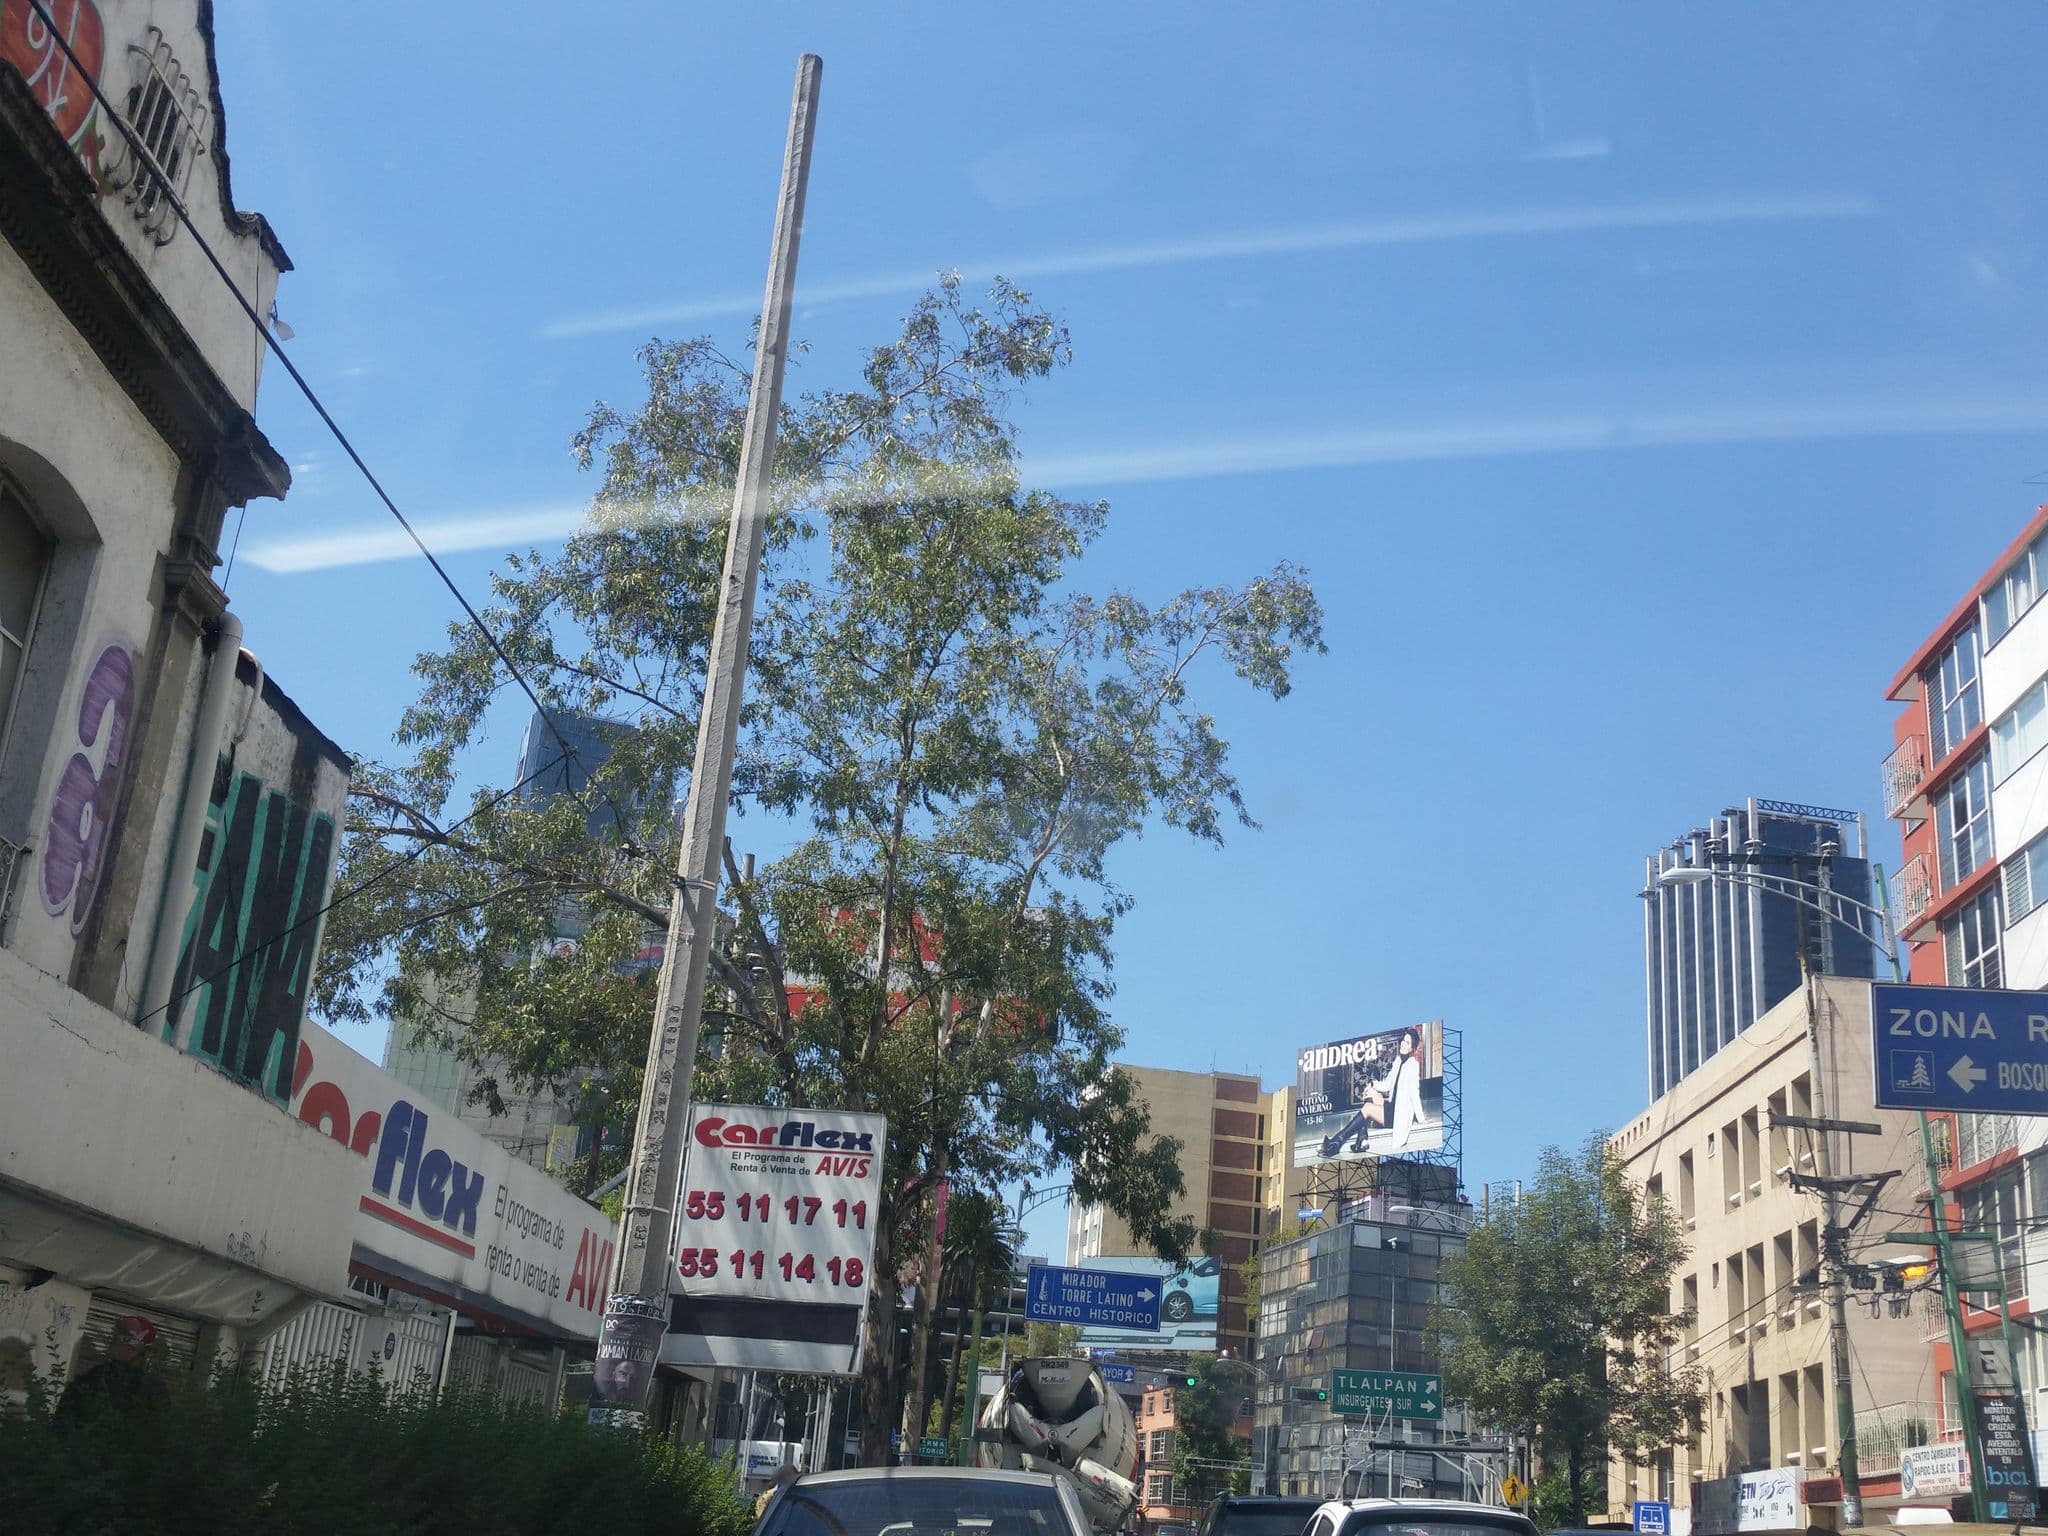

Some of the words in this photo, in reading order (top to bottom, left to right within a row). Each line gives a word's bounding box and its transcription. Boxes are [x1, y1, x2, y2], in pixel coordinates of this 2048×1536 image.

[1889, 1008, 1997, 1040] ZONA
[1302, 1093, 1329, 1107] OTOÑO
[1297, 1102, 1333, 1116] INVIERNO
[292, 1039, 485, 1239] arflex
[694, 1117, 873, 1152] Carflex
[730, 1163, 758, 1173] Renta
[770, 1164, 796, 1175] Venta
[798, 1166, 811, 1176] de
[732, 1151, 742, 1160] El
[743, 1152, 791, 1164] Programa
[793, 1155, 806, 1164] de
[814, 1155, 871, 1179] AVIS
[494, 1183, 509, 1219] El
[505, 1199, 551, 1244] programa
[552, 1218, 565, 1250] de
[686, 1190, 726, 1221] 55
[736, 1192, 771, 1223] 11
[784, 1195, 822, 1226] 17
[832, 1198, 867, 1229] 11
[484, 1243, 512, 1277] renta
[513, 1257, 521, 1281] o
[522, 1261, 546, 1293] venta
[548, 1268, 561, 1298] de
[678, 1247, 719, 1278] 55
[729, 1249, 765, 1280] 11
[778, 1252, 816, 1284] 14
[826, 1256, 864, 1288] 18
[1061, 1272, 1106, 1289] MIRADOR
[1061, 1288, 1092, 1304] TORRE
[1097, 1292, 1134, 1308] LATINO
[1033, 1303, 1081, 1318] CENTRO
[1089, 1308, 1153, 1325] HISTORICO
[1099, 1366, 1123, 1380] AYOR
[1338, 1375, 1417, 1393] TLALPAN
[1337, 1393, 1390, 1409] INSURGENTES
[1397, 1397, 1412, 1410] SUR
[1984, 1406, 2016, 1415] MINUTOS
[1991, 1414, 2011, 1423] PARA
[1987, 1422, 2016, 1431] CRUZAR
[1994, 1431, 2012, 1439] ESTA
[1912, 1451, 1930, 1463] CENTRO
[2001, 1456, 2012, 1464] EN
[1986, 1465, 2031, 1486] bici
